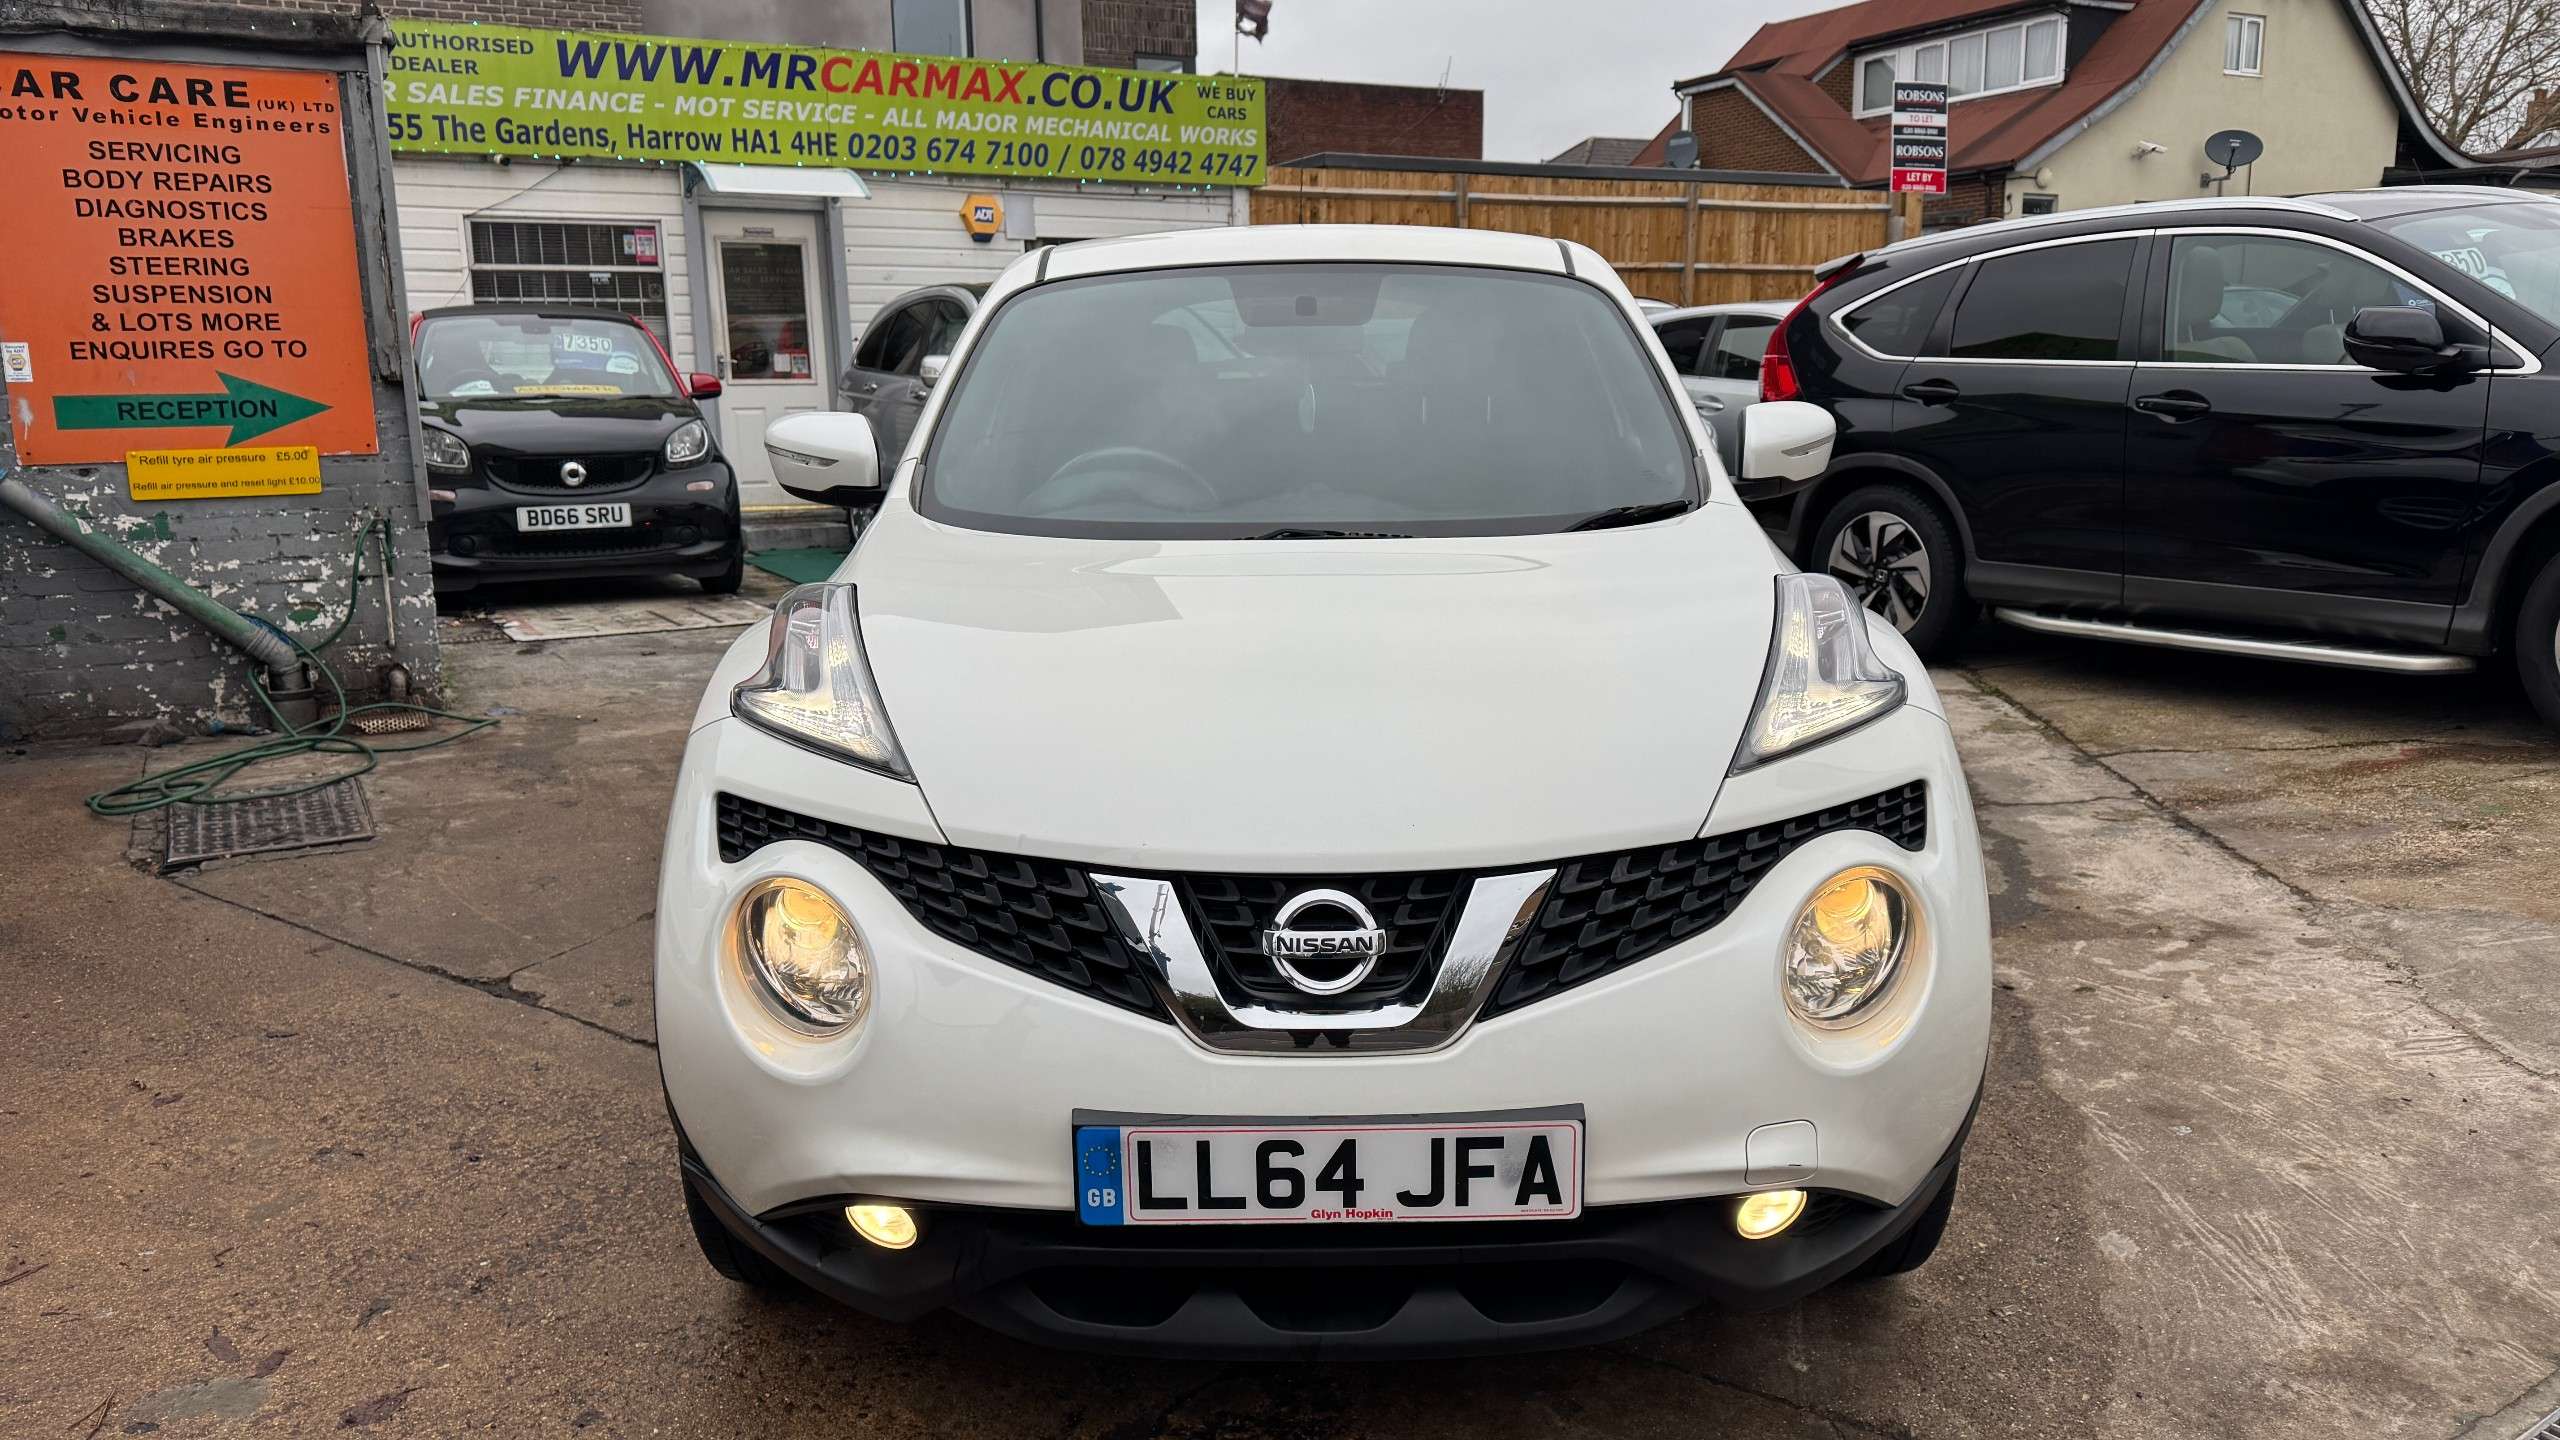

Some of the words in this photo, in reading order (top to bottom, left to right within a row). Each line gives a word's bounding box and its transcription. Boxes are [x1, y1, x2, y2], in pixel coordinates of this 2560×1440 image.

[393, 31, 534, 55] AUTHORISED
[391, 55, 480, 75] DEALER
[556, 39, 1178, 114] WWW.MRCARMAX.CO.UK
[0, 69, 84, 100] AR
[109, 74, 250, 108] CARE
[257, 100, 295, 112] (UK)
[303, 102, 334, 112] LTD
[1197, 86, 1220, 99] WE
[1226, 87, 1256, 101] BUY
[1897, 90, 1944, 103] ROBSONS
[0, 105, 58, 120] otor
[72, 107, 180, 127] Vehicle
[194, 113, 330, 134] Engineers
[407, 81, 504, 107] SALES
[513, 86, 645, 114] FINANCE
[674, 95, 735, 118] MOT
[742, 98, 857, 125] SERVICE
[882, 107, 927, 129] ALL
[935, 110, 1018, 134] MAJOR
[1025, 116, 1172, 142] MECHANICAL
[1180, 125, 1258, 147] WORKS
[1207, 106, 1247, 120] CARS
[1909, 114, 1920, 123] TO
[1922, 115, 1933, 123] LET
[89, 141, 241, 164] SERVICING
[387, 112, 423, 141] 55
[432, 114, 486, 143] The
[495, 117, 617, 154] Gardens,
[627, 123, 722, 152] Harrow
[732, 128, 781, 154] HA1
[790, 131, 838, 157] 4HE
[848, 133, 917, 161] 0203
[926, 138, 976, 164] 674
[986, 140, 1049, 168] 7100
[1057, 144, 1071, 173] /
[1080, 146, 1125, 171] 078
[1133, 149, 1193, 175] 4942
[1201, 153, 1258, 177] 4747
[1896, 145, 1943, 158] ROBSONS
[62, 169, 143, 190] BODY
[154, 172, 272, 193] REPAIRS
[1906, 172, 1921, 182] LET
[1922, 173, 1933, 182] BY
[75, 198, 268, 221] DIAGNOSTICS
[976, 207, 993, 221] ADT
[118, 227, 234, 248] BRAKES
[109, 256, 250, 276] STEERING
[93, 285, 272, 304] SUSPENSION
[92, 313, 110, 331] &
[120, 312, 192, 331] LOTS
[202, 312, 281, 331] MORE
[69, 340, 214, 360] ENQUIRES
[223, 340, 264, 359] GO
[271, 339, 307, 358] TO
[117, 400, 278, 421] RECEPTION
[139, 455, 169, 465] Refill
[172, 455, 194, 467] tyre
[198, 453, 211, 464] air
[216, 453, 266, 464] pressure
[276, 450, 308, 461] £5.00
[133, 482, 158, 491] Refill
[160, 481, 172, 490] air
[176, 480, 218, 491] pressure
[220, 479, 237, 488] and
[241, 478, 265, 487] reset
[267, 477, 286, 489] light
[527, 508, 579, 526] BD66
[585, 506, 623, 524] SRU
[1277, 936, 1372, 953] NISSAN
[1137, 1138, 1364, 1210] LL64
[1396, 1135, 1562, 1207] JFA
[1088, 1188, 1115, 1207] GB
[1311, 1209, 1341, 1220] Glyn
[1345, 1208, 1393, 1220] Hopkin
